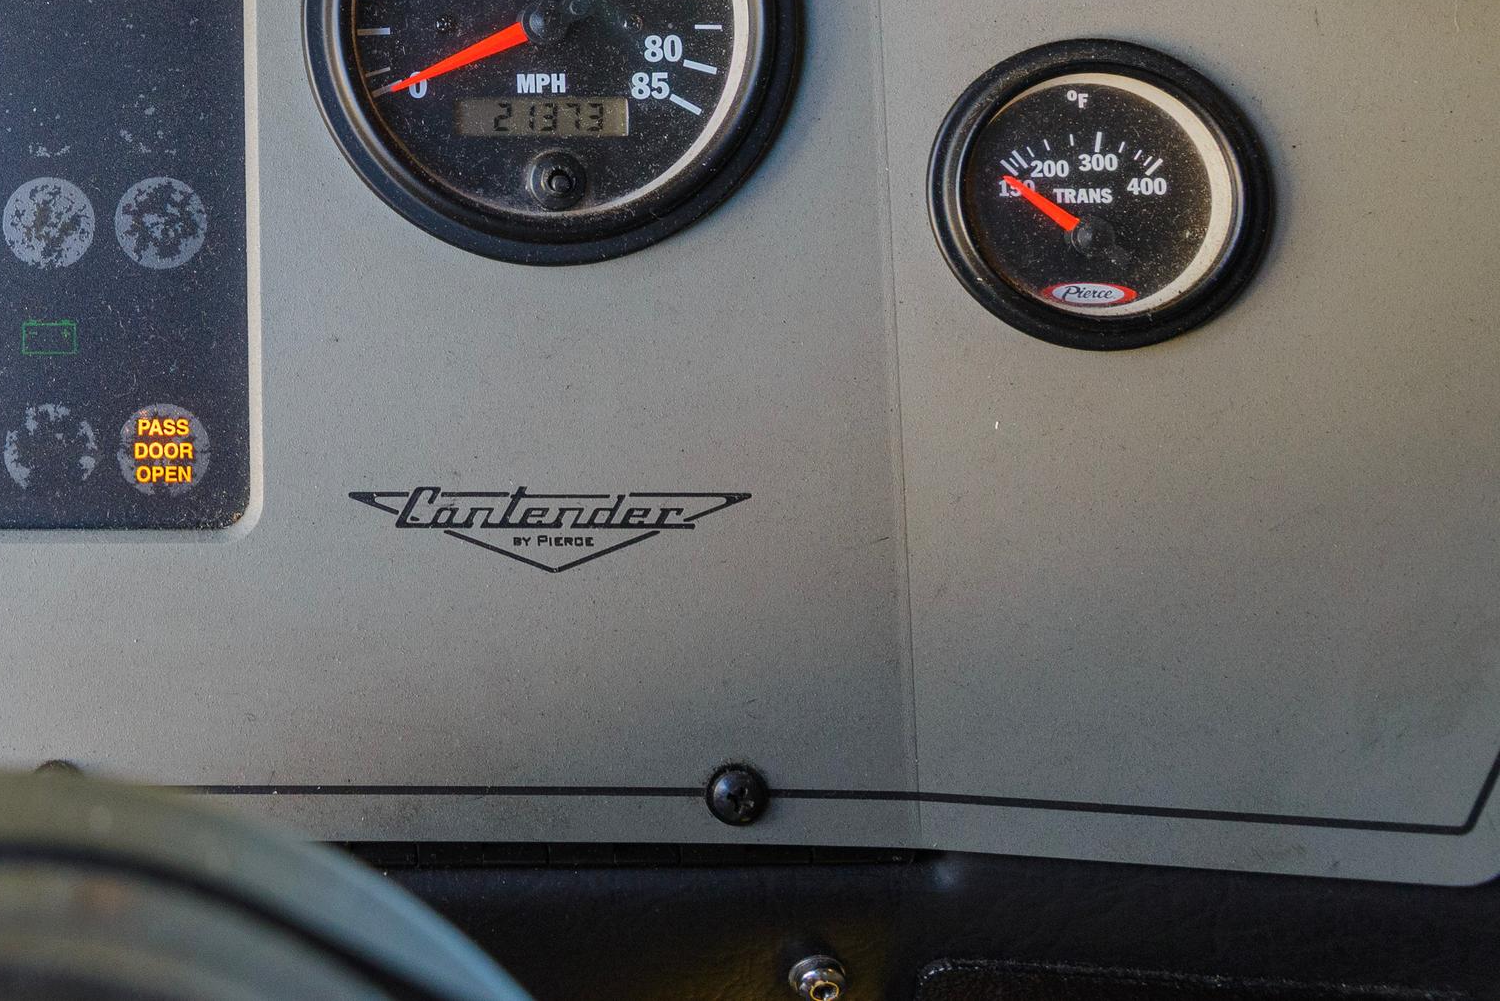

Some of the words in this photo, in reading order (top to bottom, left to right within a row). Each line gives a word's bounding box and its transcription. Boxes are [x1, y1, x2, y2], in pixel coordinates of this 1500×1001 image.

[644, 35, 682, 62] 80
[409, 71, 428, 99] 0
[516, 73, 566, 93] MPH
[631, 72, 669, 99] 85
[493, 103, 604, 131] 21373
[1030, 160, 1069, 178] 200
[1078, 154, 1118, 171] 300
[1127, 178, 1167, 195] 400
[1053, 188, 1113, 204] TRANS
[1061, 286, 1113, 299] Pierce
[137, 418, 189, 435] PASS
[134, 442, 193, 459] DOOR
[136, 465, 192, 482] OPEN
[513, 536, 531, 547] BY
